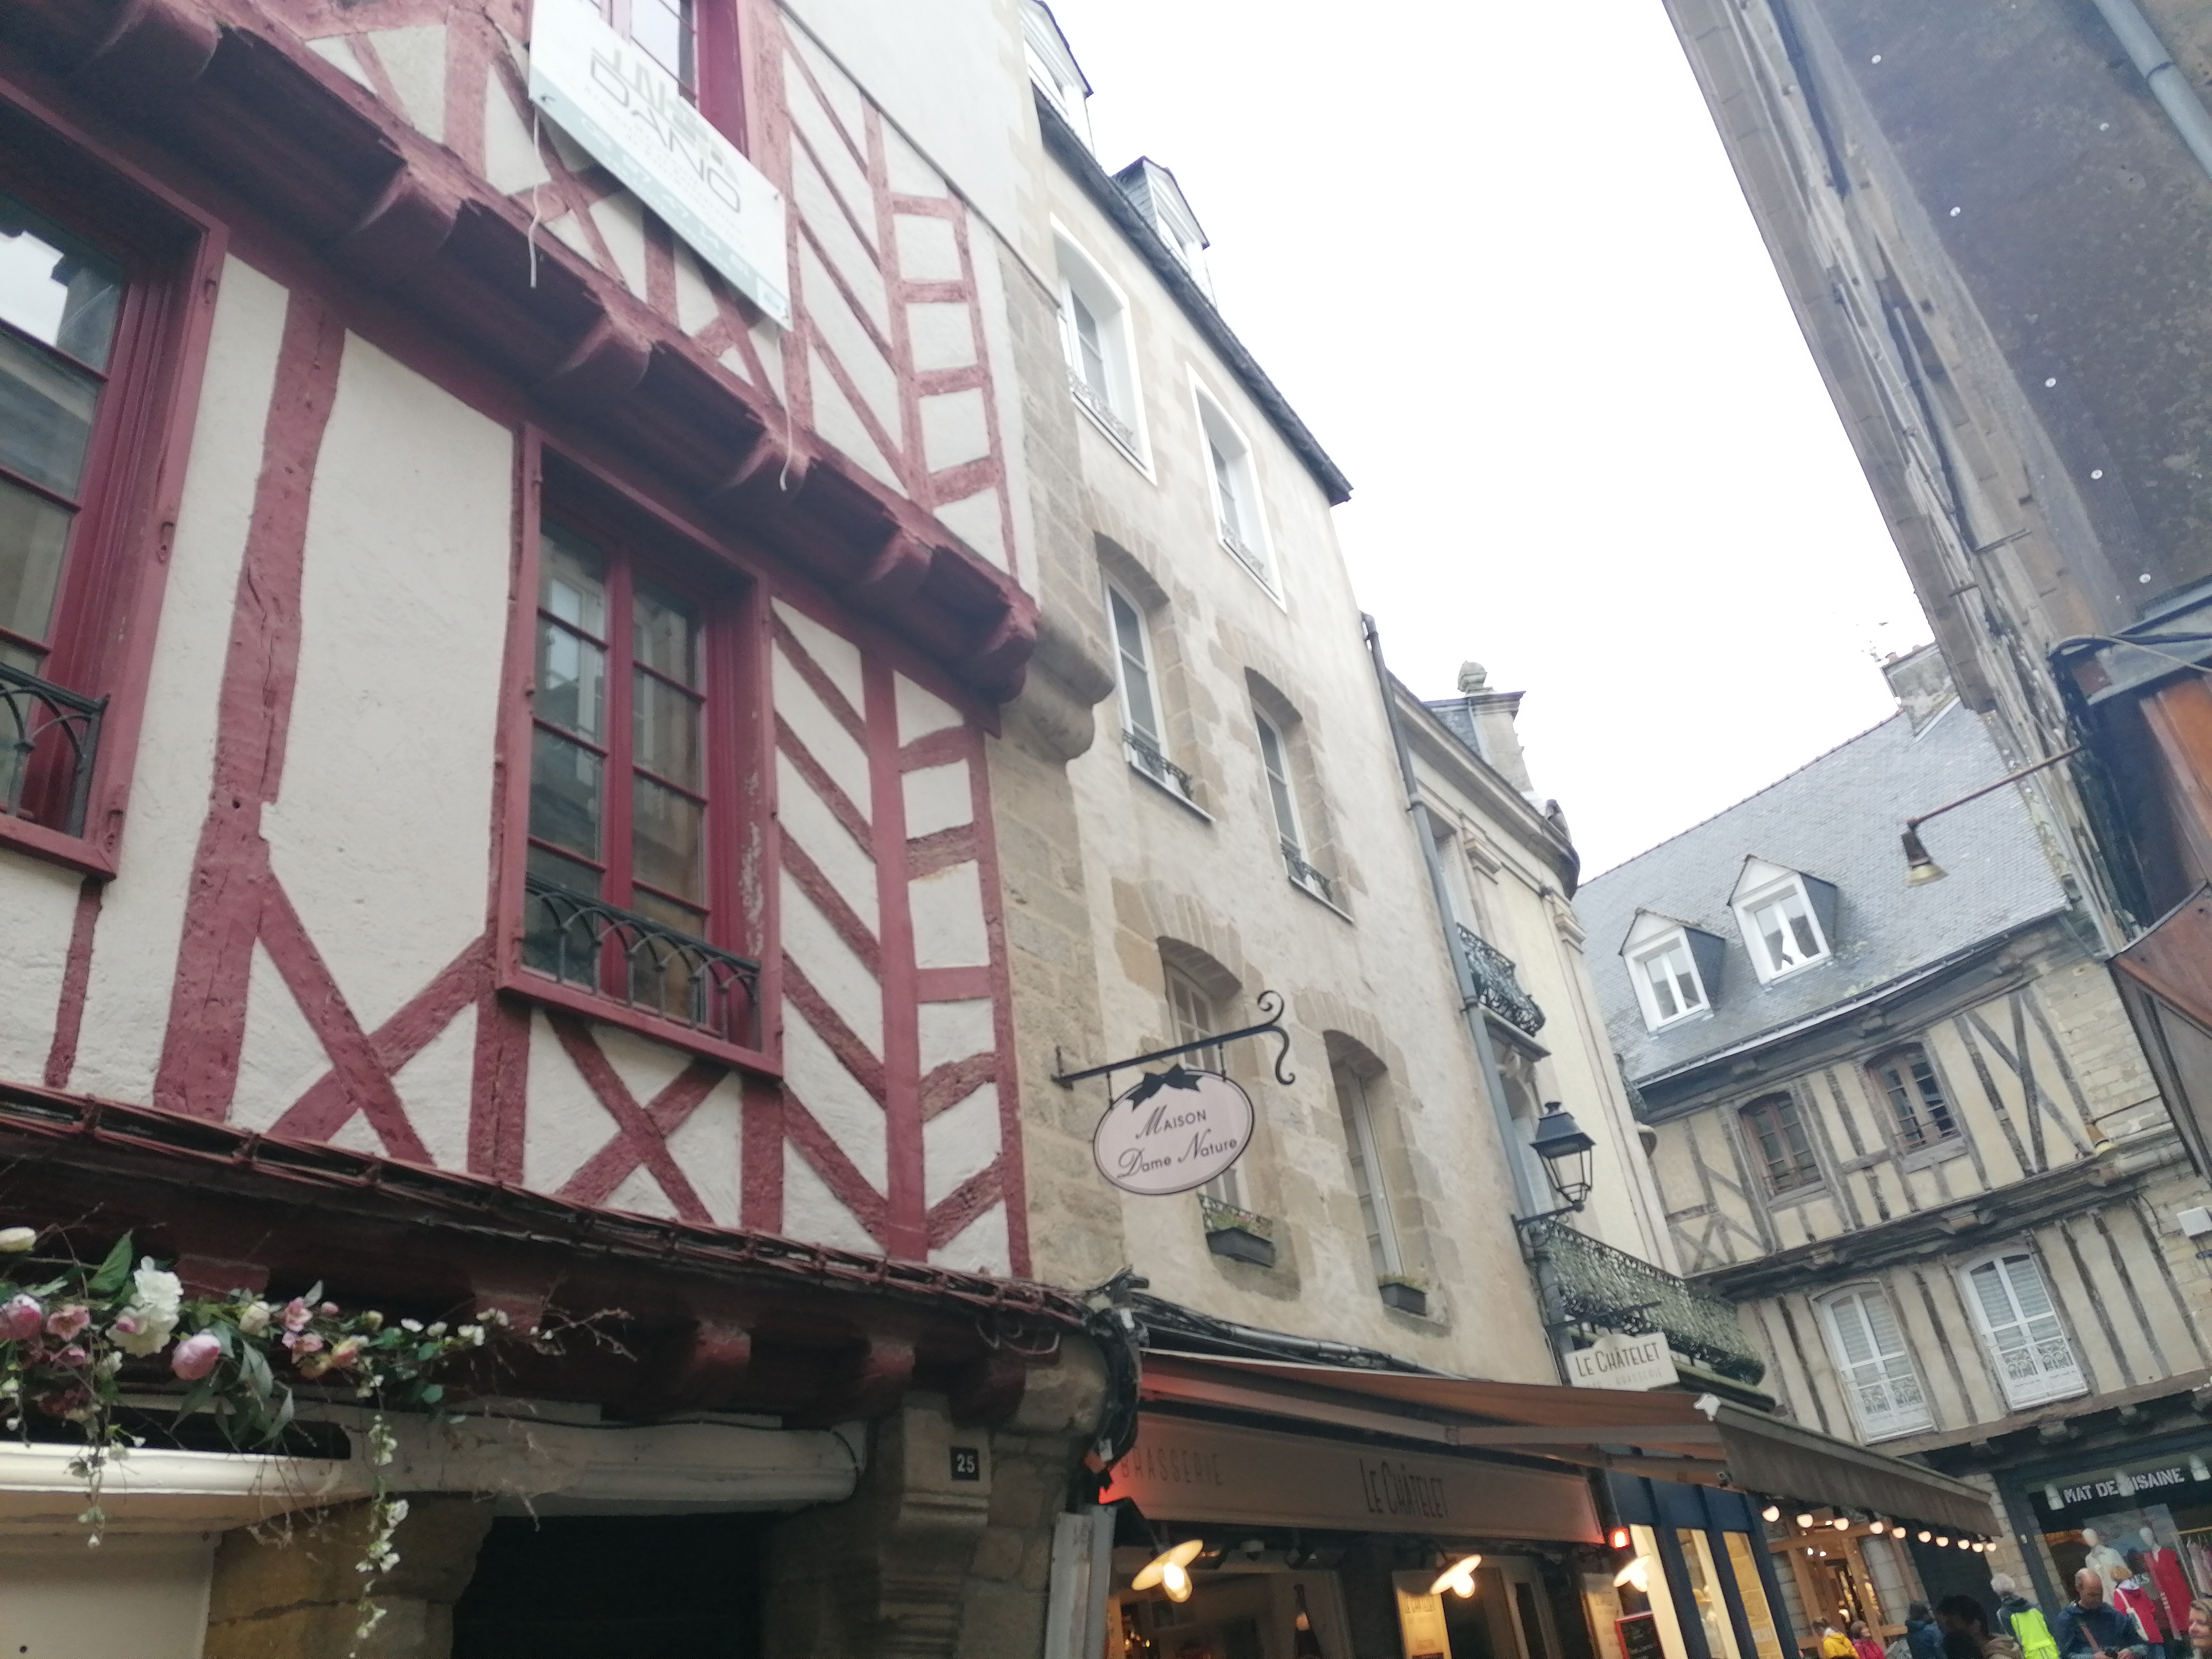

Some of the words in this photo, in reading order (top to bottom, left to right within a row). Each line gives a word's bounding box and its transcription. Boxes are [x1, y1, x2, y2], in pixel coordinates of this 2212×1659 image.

[590, 54, 740, 213] DANO
[1135, 1104, 1207, 1140] MAISON
[1116, 1146, 1172, 1179] Dame
[1178, 1127, 1238, 1164] Nature
[1575, 1355, 1595, 1377] LE
[1595, 1342, 1661, 1373] CHÂTELET
[957, 1453, 975, 1473] 25
[1359, 1457, 1384, 1513] LE
[2063, 1485, 2093, 1503] MAT
[2095, 1480, 2119, 1498] DE
[2127, 1467, 2185, 1491] ISAINE
